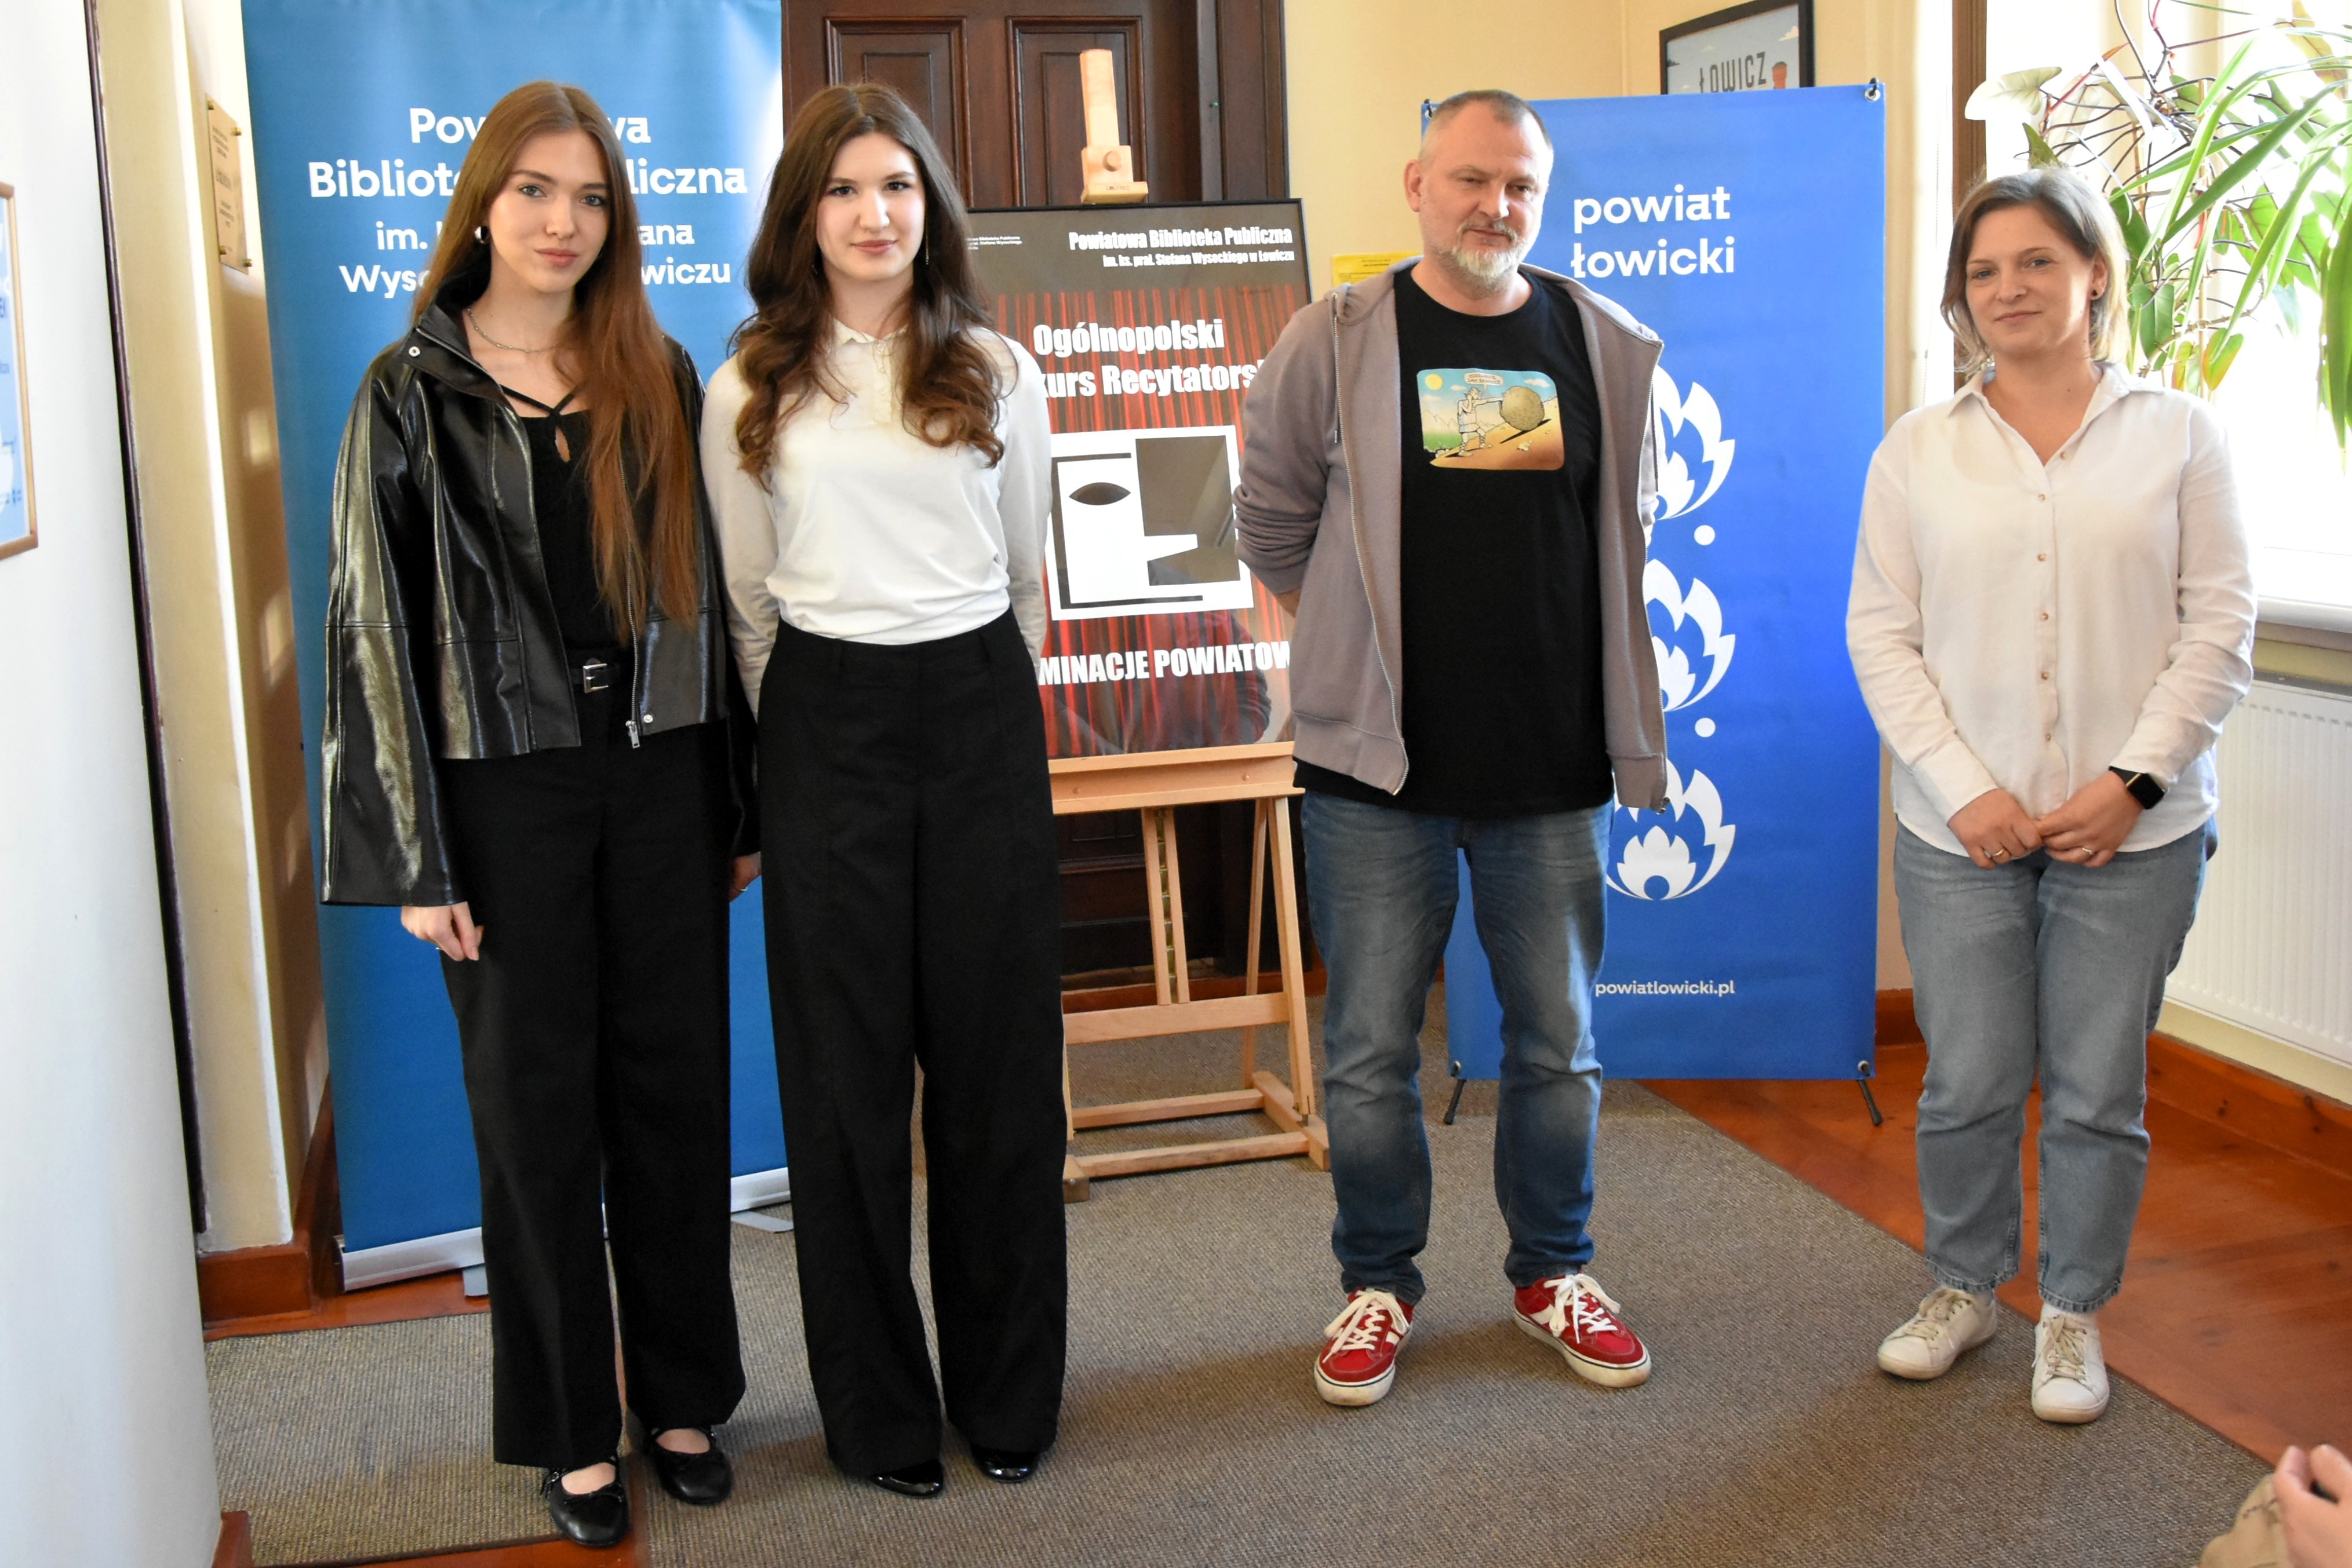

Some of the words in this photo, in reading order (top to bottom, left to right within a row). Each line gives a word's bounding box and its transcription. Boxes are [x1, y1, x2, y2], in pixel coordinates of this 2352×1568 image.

[626, 158, 748, 195] liczna
[1574, 183, 1731, 234] powiat
[376, 220, 428, 250] im.
[1068, 231, 1148, 250] Powiatowa
[1149, 228, 1223, 248] Biblioteka
[1224, 226, 1293, 245] Publiczna
[640, 256, 731, 285] wiczu
[1102, 255, 1119, 267] im.
[1155, 253, 1192, 266] Stefana
[1192, 251, 1248, 265] Wysockiego
[1248, 253, 1258, 262] w
[1258, 249, 1295, 262] Łowiczu
[1570, 235, 1735, 278] łowicki
[1033, 319, 1225, 358] Ogólnopolski
[1101, 359, 1265, 397] Recytators
[1038, 650, 1150, 686] MINACJE
[1153, 640, 1291, 679] POWIATOW
[1595, 980, 1735, 997] powiatlowicki.pl
